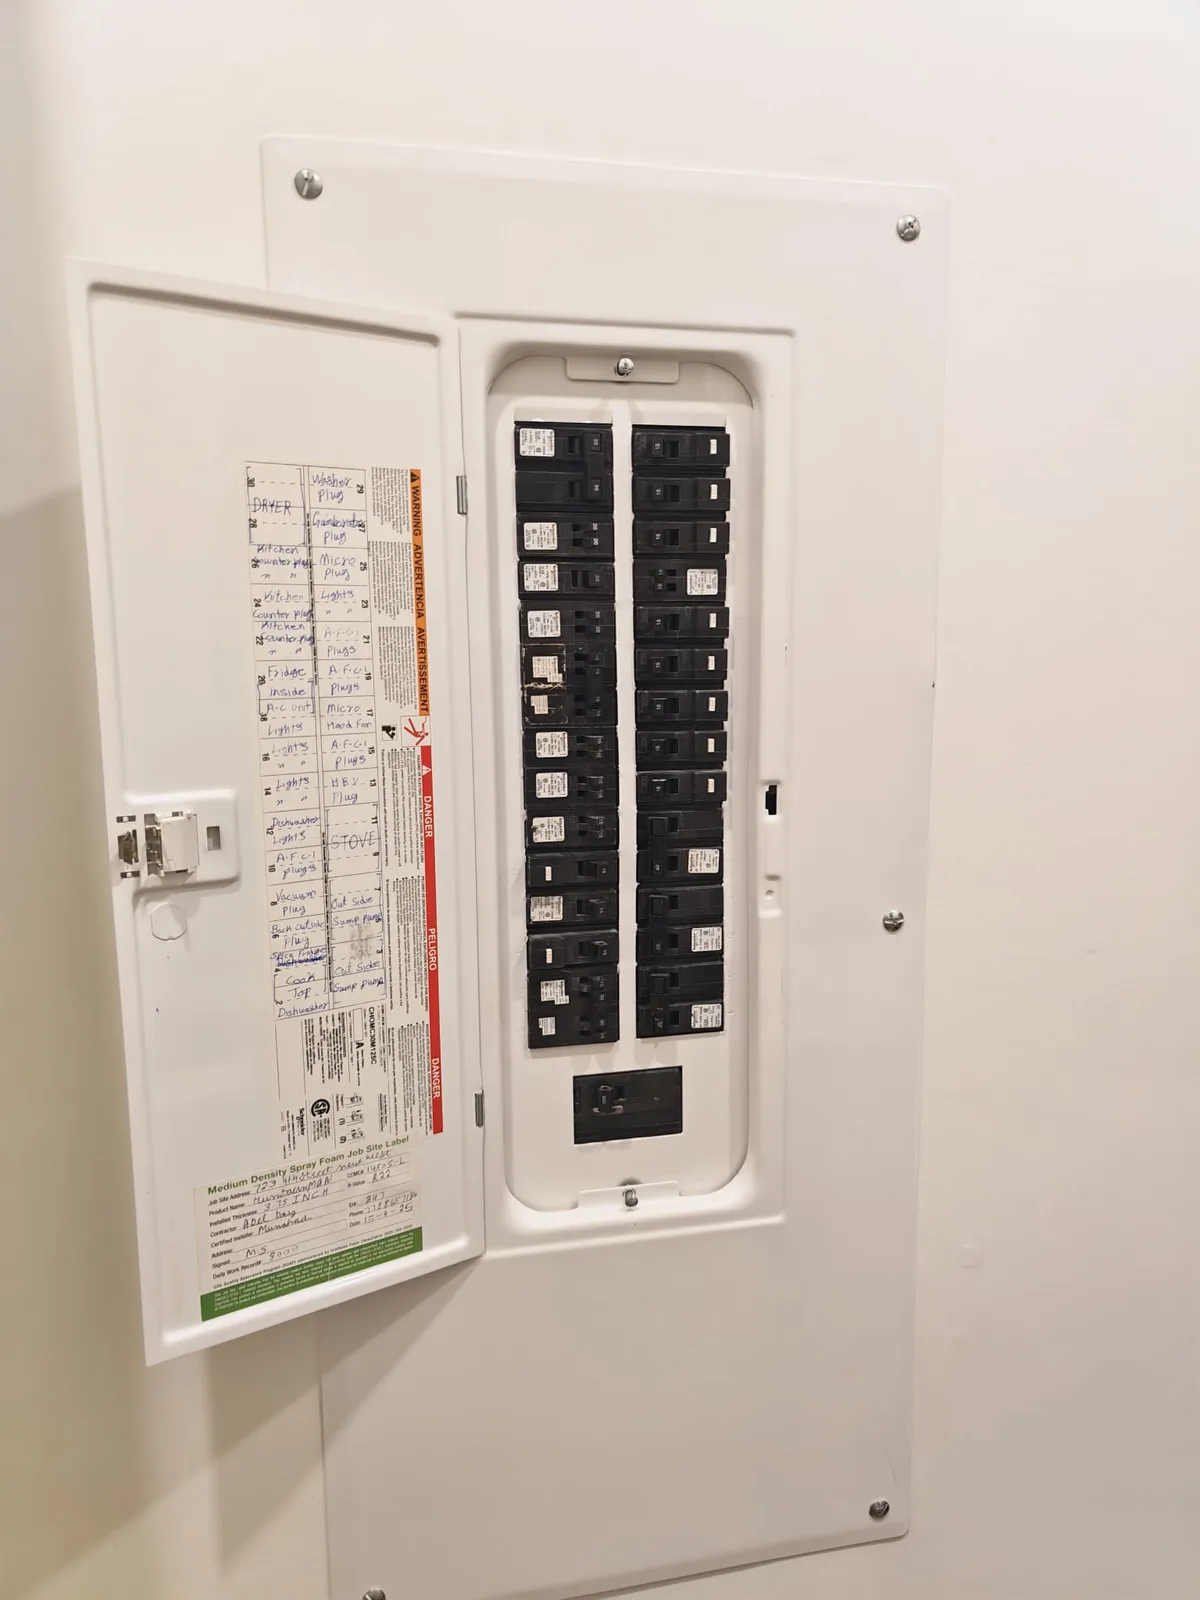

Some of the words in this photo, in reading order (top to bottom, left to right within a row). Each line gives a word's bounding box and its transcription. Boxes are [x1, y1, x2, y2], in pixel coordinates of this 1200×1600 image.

[248, 478, 255, 487] 30
[357, 484, 364, 494] 29
[252, 498, 292, 515] DRYER
[411, 486, 421, 536] WARNING
[249, 518, 257, 528] 28
[320, 554, 355, 566] Micro
[360, 562, 367, 571] 25
[413, 544, 424, 620] ADVERTENCIA
[264, 590, 303, 600] Kitchen
[254, 599, 261, 607] 24
[361, 600, 368, 608] 23
[253, 609, 288, 619] Counter
[256, 636, 263, 645] 22
[363, 635, 370, 644] 21
[417, 628, 429, 712] AVERTISSEMENT
[258, 675, 266, 685] 20
[365, 672, 372, 680] 19
[260, 713, 267, 722] 18
[366, 709, 373, 717] 17
[262, 753, 270, 761] 16
[276, 777, 309, 790] Lights
[370, 779, 376, 787] 13
[424, 796, 432, 838] DANGER
[330, 831, 376, 850] STOVE
[428, 928, 437, 971] PELIGRO
[432, 1058, 440, 1098] DANGER
[208, 1179, 248, 1195] Medium
[251, 1169, 287, 1184] Density
[290, 1161, 316, 1174] Spray
[320, 1153, 344, 1165] Foam
[347, 1148, 364, 1158] Job
[366, 1143, 383, 1152] Site
[386, 1136, 409, 1148] Label
